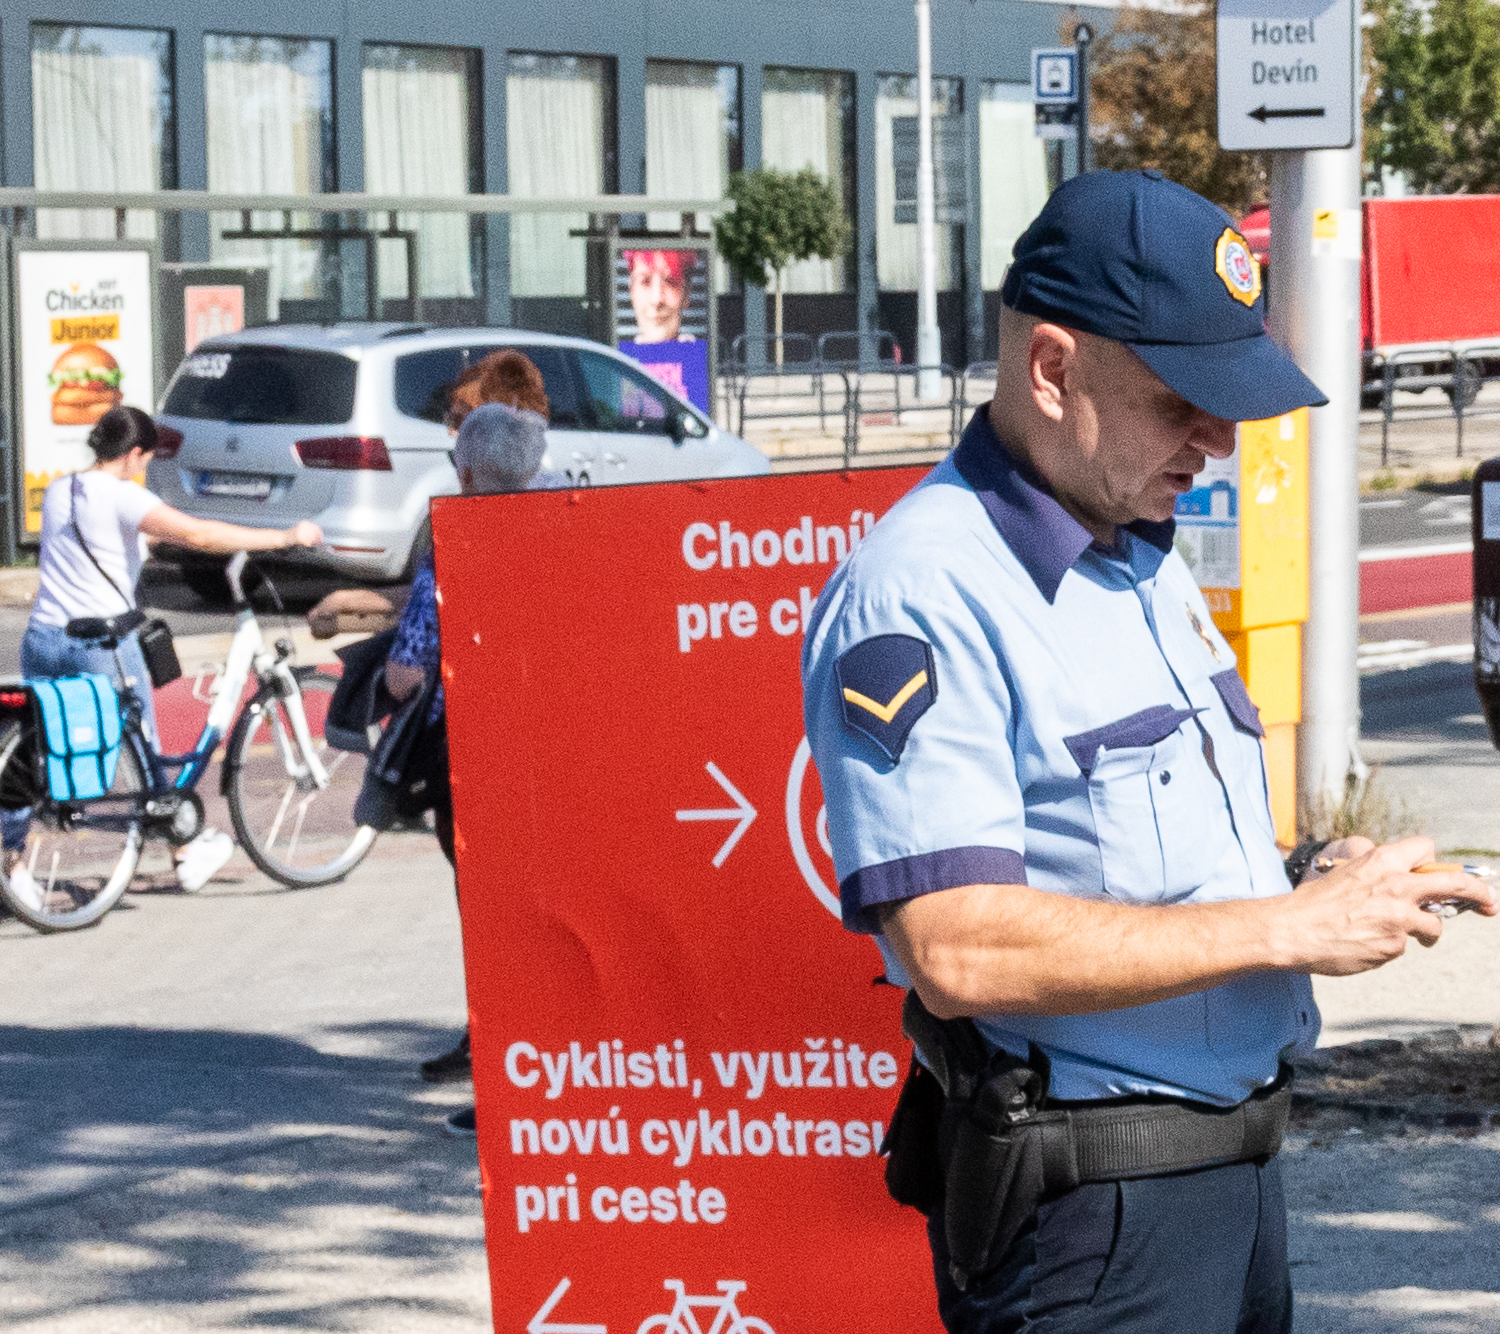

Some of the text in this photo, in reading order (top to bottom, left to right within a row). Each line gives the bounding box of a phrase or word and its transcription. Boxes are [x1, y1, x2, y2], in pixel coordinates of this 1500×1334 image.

[1251, 19, 1316, 46] Hotel
[1252, 59, 1318, 85] Devín
[45, 288, 124, 312] Chicken
[54, 317, 116, 341] Junior
[682, 509, 876, 571] Chodní
[677, 602, 757, 653] pre
[504, 1036, 898, 1099] Cyklisti, využite
[510, 1106, 630, 1155] novú
[515, 1174, 727, 1233] pri ceste
